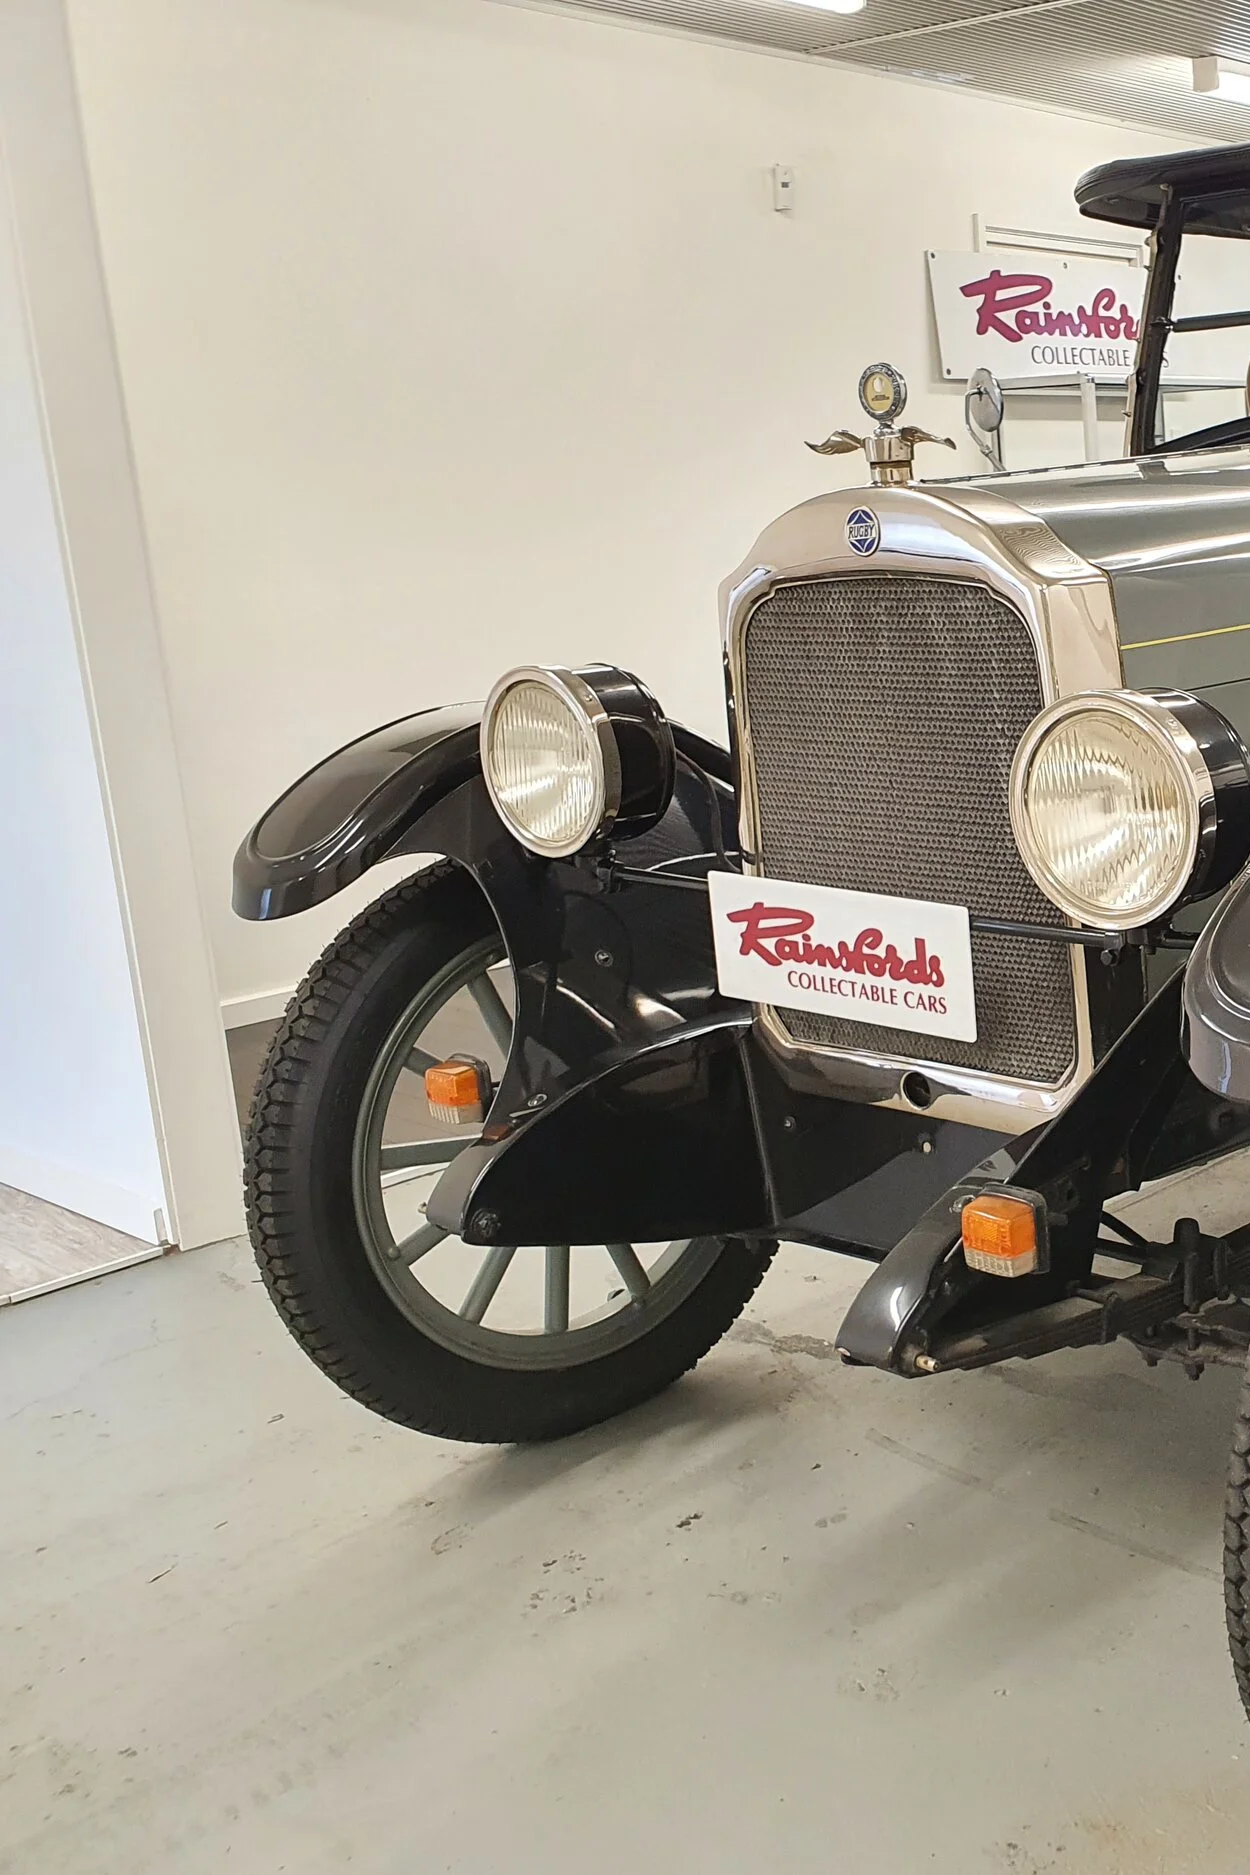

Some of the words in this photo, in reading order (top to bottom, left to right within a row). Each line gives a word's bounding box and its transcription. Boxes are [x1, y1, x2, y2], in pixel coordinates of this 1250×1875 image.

[959, 269, 1140, 342] Rainsfor
[1031, 345, 1130, 367] COLLECTABLE
[848, 524, 875, 539] RUGBY
[726, 902, 945, 988] Rainsfords
[787, 970, 899, 1006] COLLECTABLE
[903, 991, 948, 1015] CARS
